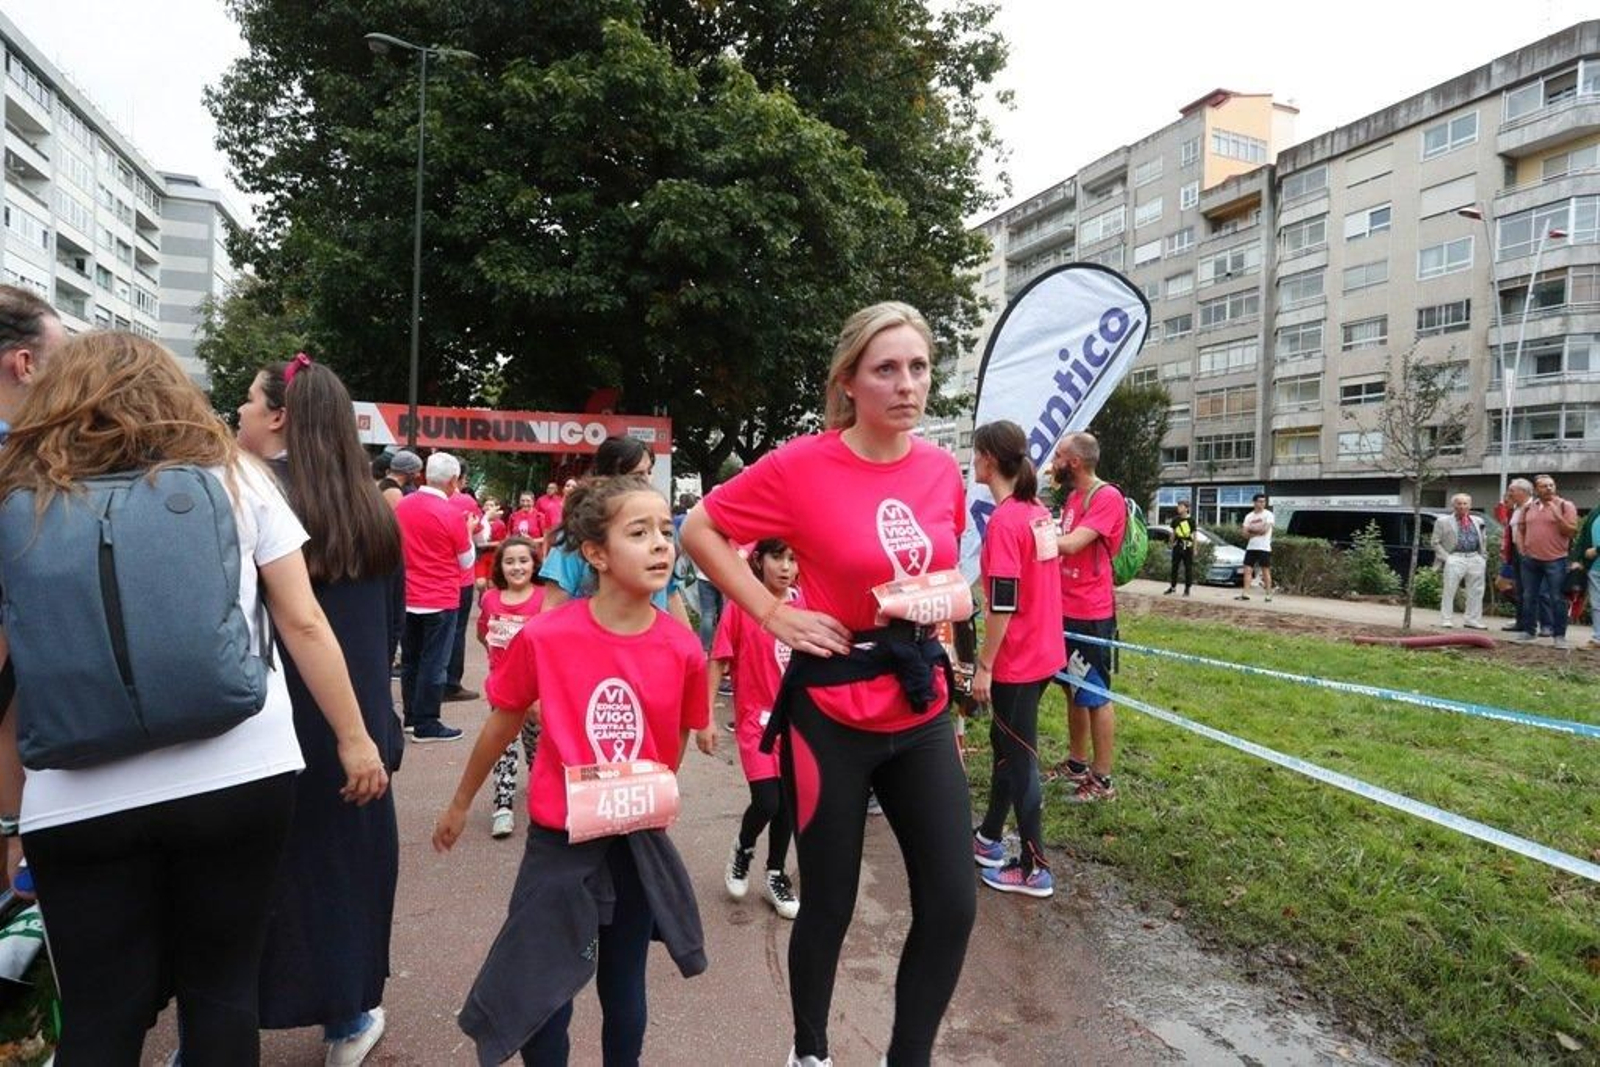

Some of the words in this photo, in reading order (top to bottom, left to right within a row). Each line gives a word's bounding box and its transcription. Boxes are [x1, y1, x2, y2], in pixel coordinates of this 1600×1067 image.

[885, 507, 904, 520] VI
[885, 526, 917, 539] VIGO
[604, 688, 624, 703] VI
[594, 710, 635, 723] VIGO
[596, 784, 656, 820] 4851
